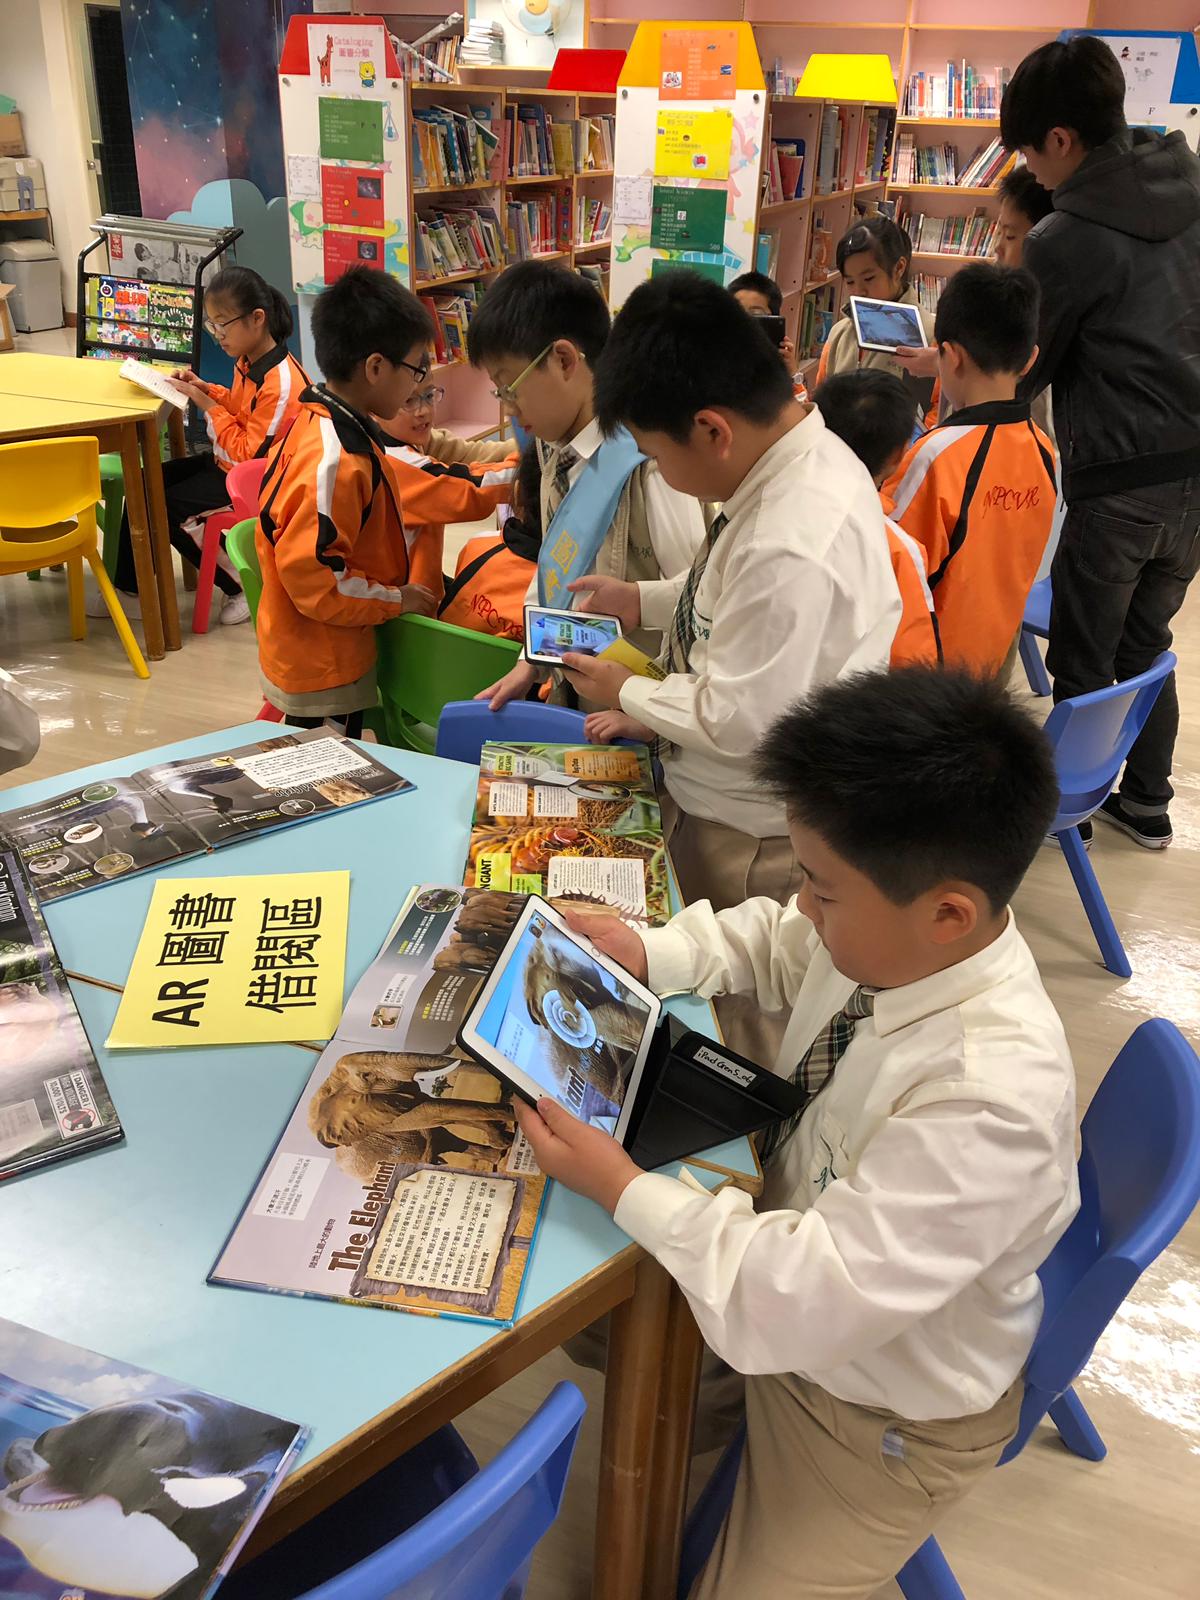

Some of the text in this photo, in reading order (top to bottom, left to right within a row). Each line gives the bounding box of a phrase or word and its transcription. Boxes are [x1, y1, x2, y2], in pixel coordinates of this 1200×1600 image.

[480, 859, 491, 883] GIANT
[152, 892, 237, 1027] AR 圖書
[245, 896, 322, 1014] 借閱區
[697, 1049, 718, 1065] iPad
[328, 1160, 396, 1270] The Elephant
